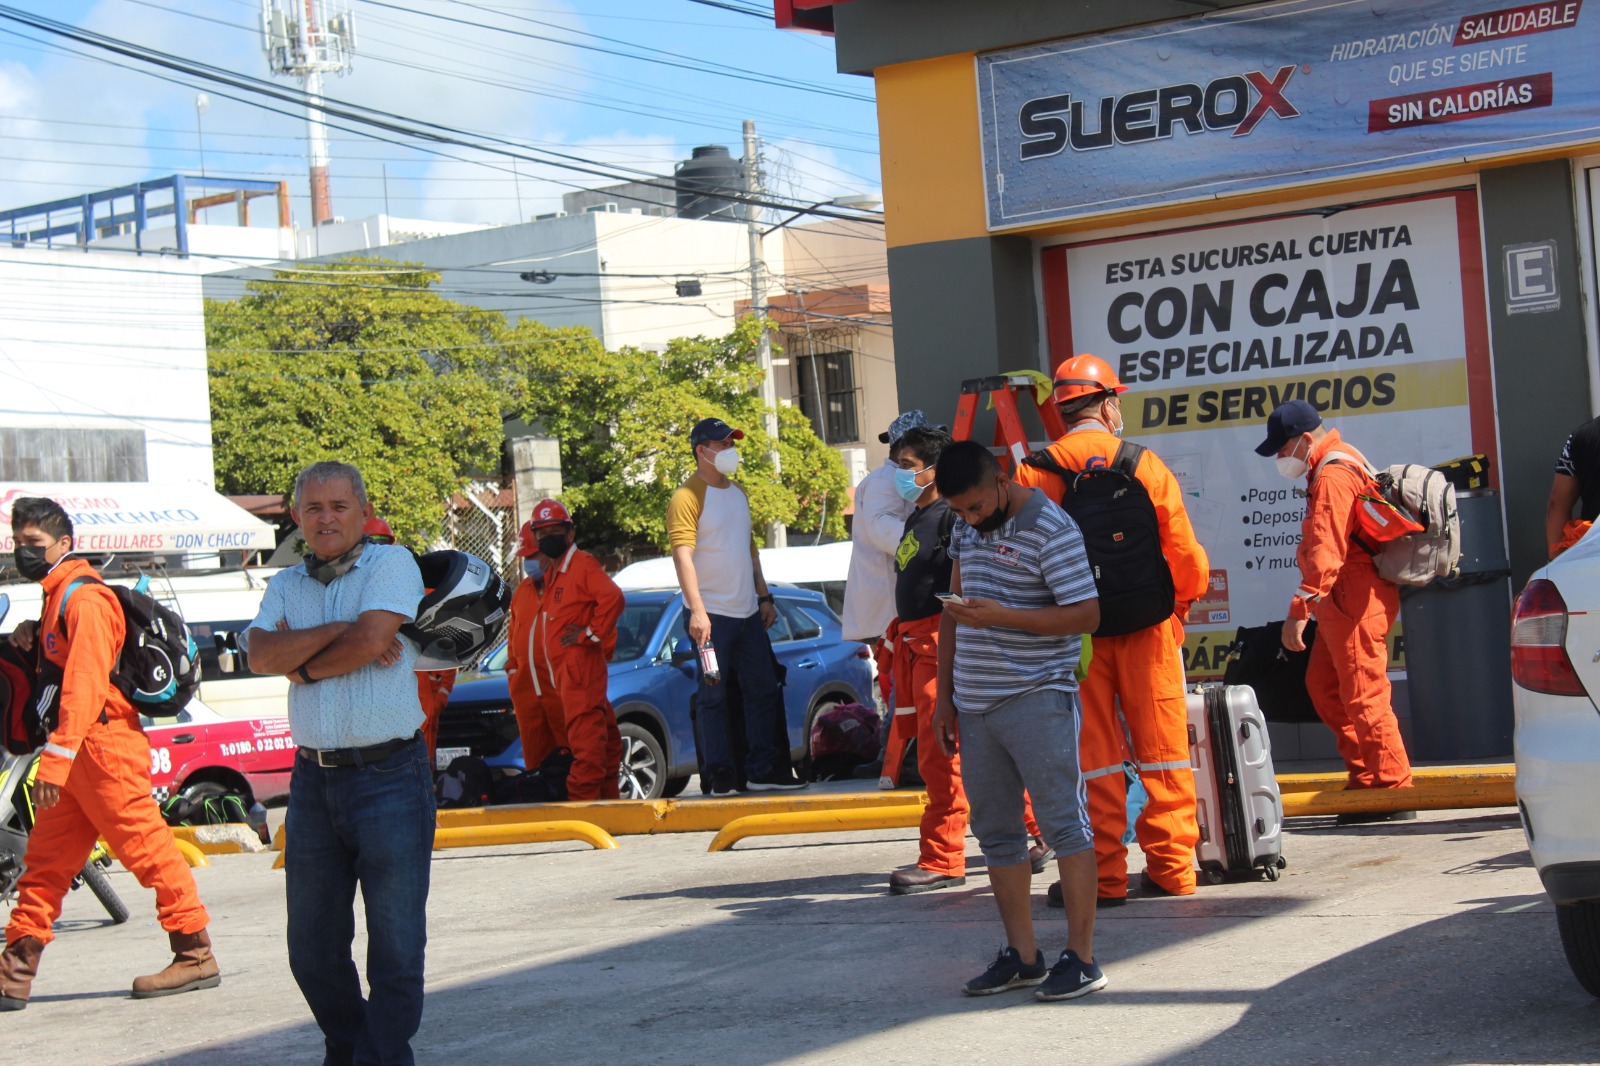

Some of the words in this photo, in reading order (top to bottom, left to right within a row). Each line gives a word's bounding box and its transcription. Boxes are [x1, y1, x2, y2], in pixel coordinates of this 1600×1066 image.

[1330, 22, 1454, 62] HIDRATACIÓN
[1461, 3, 1577, 40] SALUDABLE
[1389, 60, 1427, 86] QUE
[1431, 56, 1456, 77] SE
[1459, 44, 1528, 72] SIENTE
[1019, 64, 1300, 161] SUEROX
[1388, 100, 1423, 124] SIN
[1429, 82, 1533, 121] CALORÍAS
[1105, 257, 1165, 284] ESTA
[1170, 239, 1302, 275] SUCURSAL
[1308, 224, 1413, 257] CUENTA
[1516, 251, 1547, 295] E
[1107, 279, 1235, 344] CON
[1249, 258, 1420, 327] CAJA
[1118, 322, 1414, 384] ESPECIALIZADA
[1142, 394, 1190, 429] DE
[1196, 372, 1396, 423] SERVICIOS
[115, 509, 199, 524] CHACO
[1248, 488, 1287, 505] Paga
[1252, 507, 1306, 527] Deposi
[90, 534, 163, 549] CELULARES
[1254, 531, 1304, 548] Envios
[1255, 555, 1266, 570] Y
[1211, 612, 1228, 620] VISA
[1182, 636, 1230, 672] RÁP
